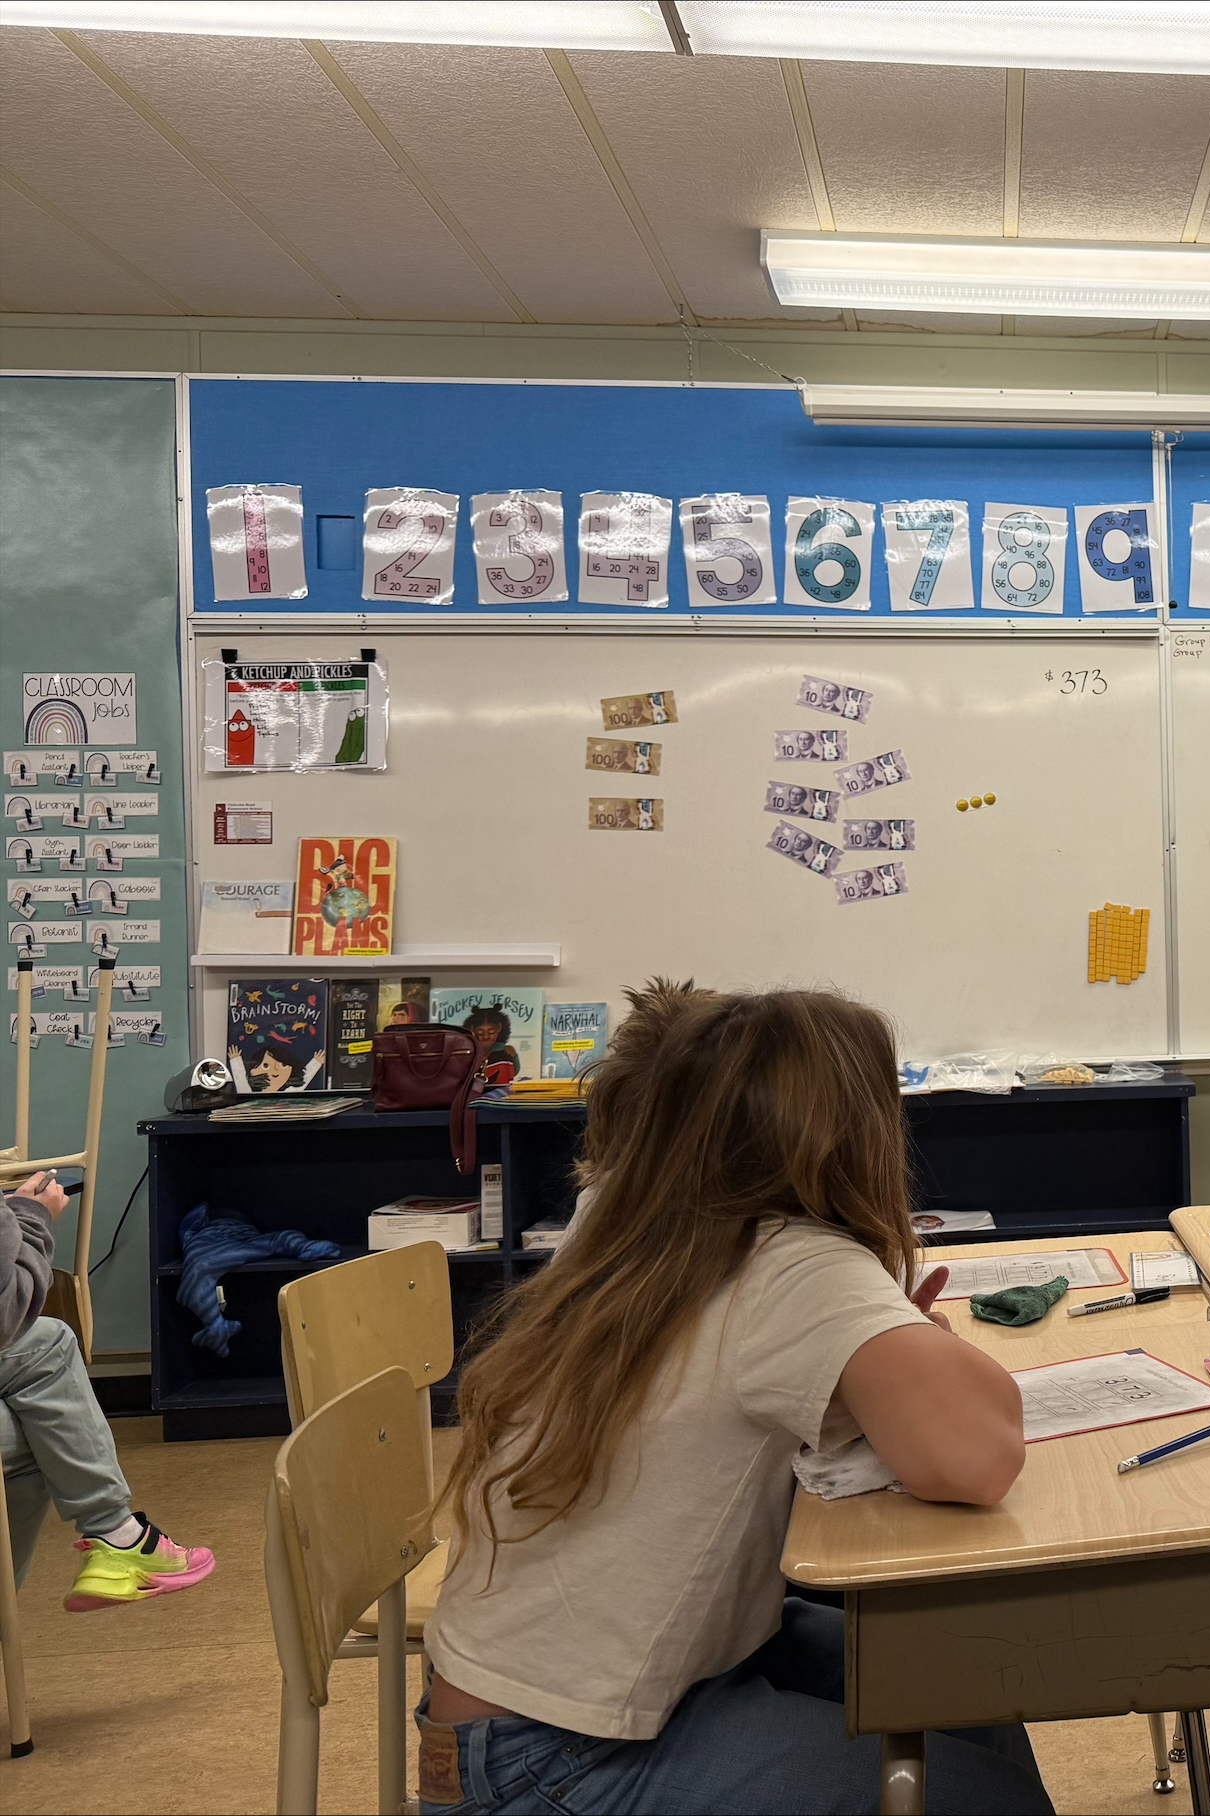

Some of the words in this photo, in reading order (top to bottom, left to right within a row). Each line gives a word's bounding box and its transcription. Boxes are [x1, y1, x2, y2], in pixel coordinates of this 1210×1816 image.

[1105, 517, 1115, 525] 36
[243, 493, 271, 593] 1
[374, 500, 445, 598] 2
[486, 499, 554, 598] 3
[587, 509, 659, 600] 4
[692, 506, 762, 601] 5
[795, 507, 862, 603] 6
[895, 509, 954, 606] 7
[991, 512, 1054, 607] 8
[1086, 509, 1154, 603] 9
[538, 558, 549, 567] 24
[609, 564, 621, 573] 20
[845, 559, 856, 568] 60
[258, 566, 266, 574] 10
[922, 569, 933, 577] 70
[701, 574, 713, 583] 60
[995, 579, 1006, 588] 56
[390, 582, 401, 591] 20
[1137, 590, 1150, 599] 108
[1175, 635, 1205, 647] Group
[1173, 647, 1202, 657] Group
[242, 667, 287, 680] KETCHUP
[290, 667, 310, 679] AND
[315, 666, 353, 678] PICKLES
[25, 677, 133, 697] CLASSROOM
[806, 691, 817, 703] 10
[92, 699, 129, 722] jobs
[609, 712, 628, 725] 100
[781, 745, 794, 756] 10
[592, 753, 611, 765] 100
[846, 780, 859, 791] 10
[35, 799, 75, 809] Librarian
[772, 797, 785, 808] 10
[594, 813, 614, 825] 100
[776, 836, 789, 849] 10
[850, 834, 862, 845] 10
[297, 838, 391, 916] BIG
[216, 884, 280, 897] OURAGE
[842, 886, 855, 898] 10
[295, 917, 390, 956] PLANS
[231, 1001, 321, 1024] BRAINSTORM!
[438, 994, 483, 1022] HOCKEY
[489, 994, 534, 1022] JERSEY
[342, 1010, 366, 1020] RIGHT
[551, 1013, 600, 1031] NARWHAL
[341, 1029, 366, 1039] LEARN
